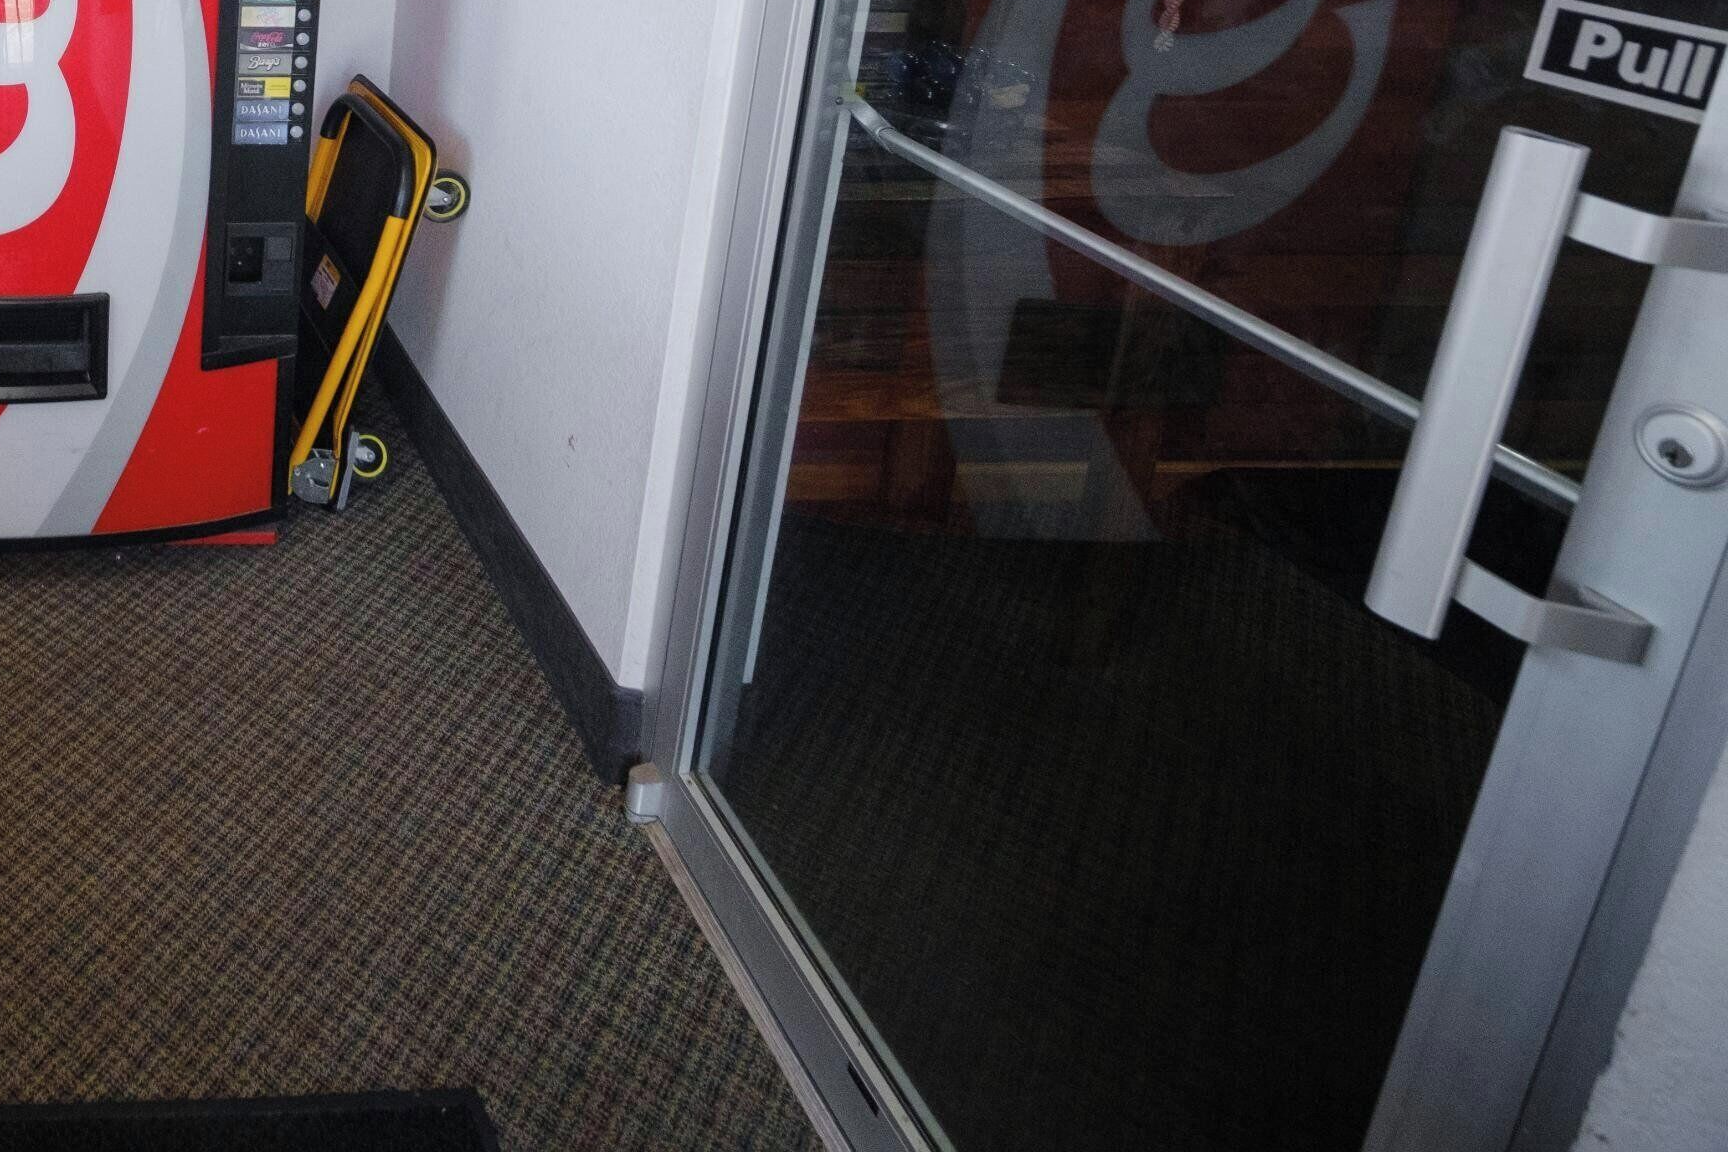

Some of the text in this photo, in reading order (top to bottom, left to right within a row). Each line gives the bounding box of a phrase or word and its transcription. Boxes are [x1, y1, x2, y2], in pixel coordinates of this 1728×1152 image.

[1569, 19, 1717, 100] Pull
[241, 104, 282, 115] DASANI
[240, 128, 281, 139] DASANI
